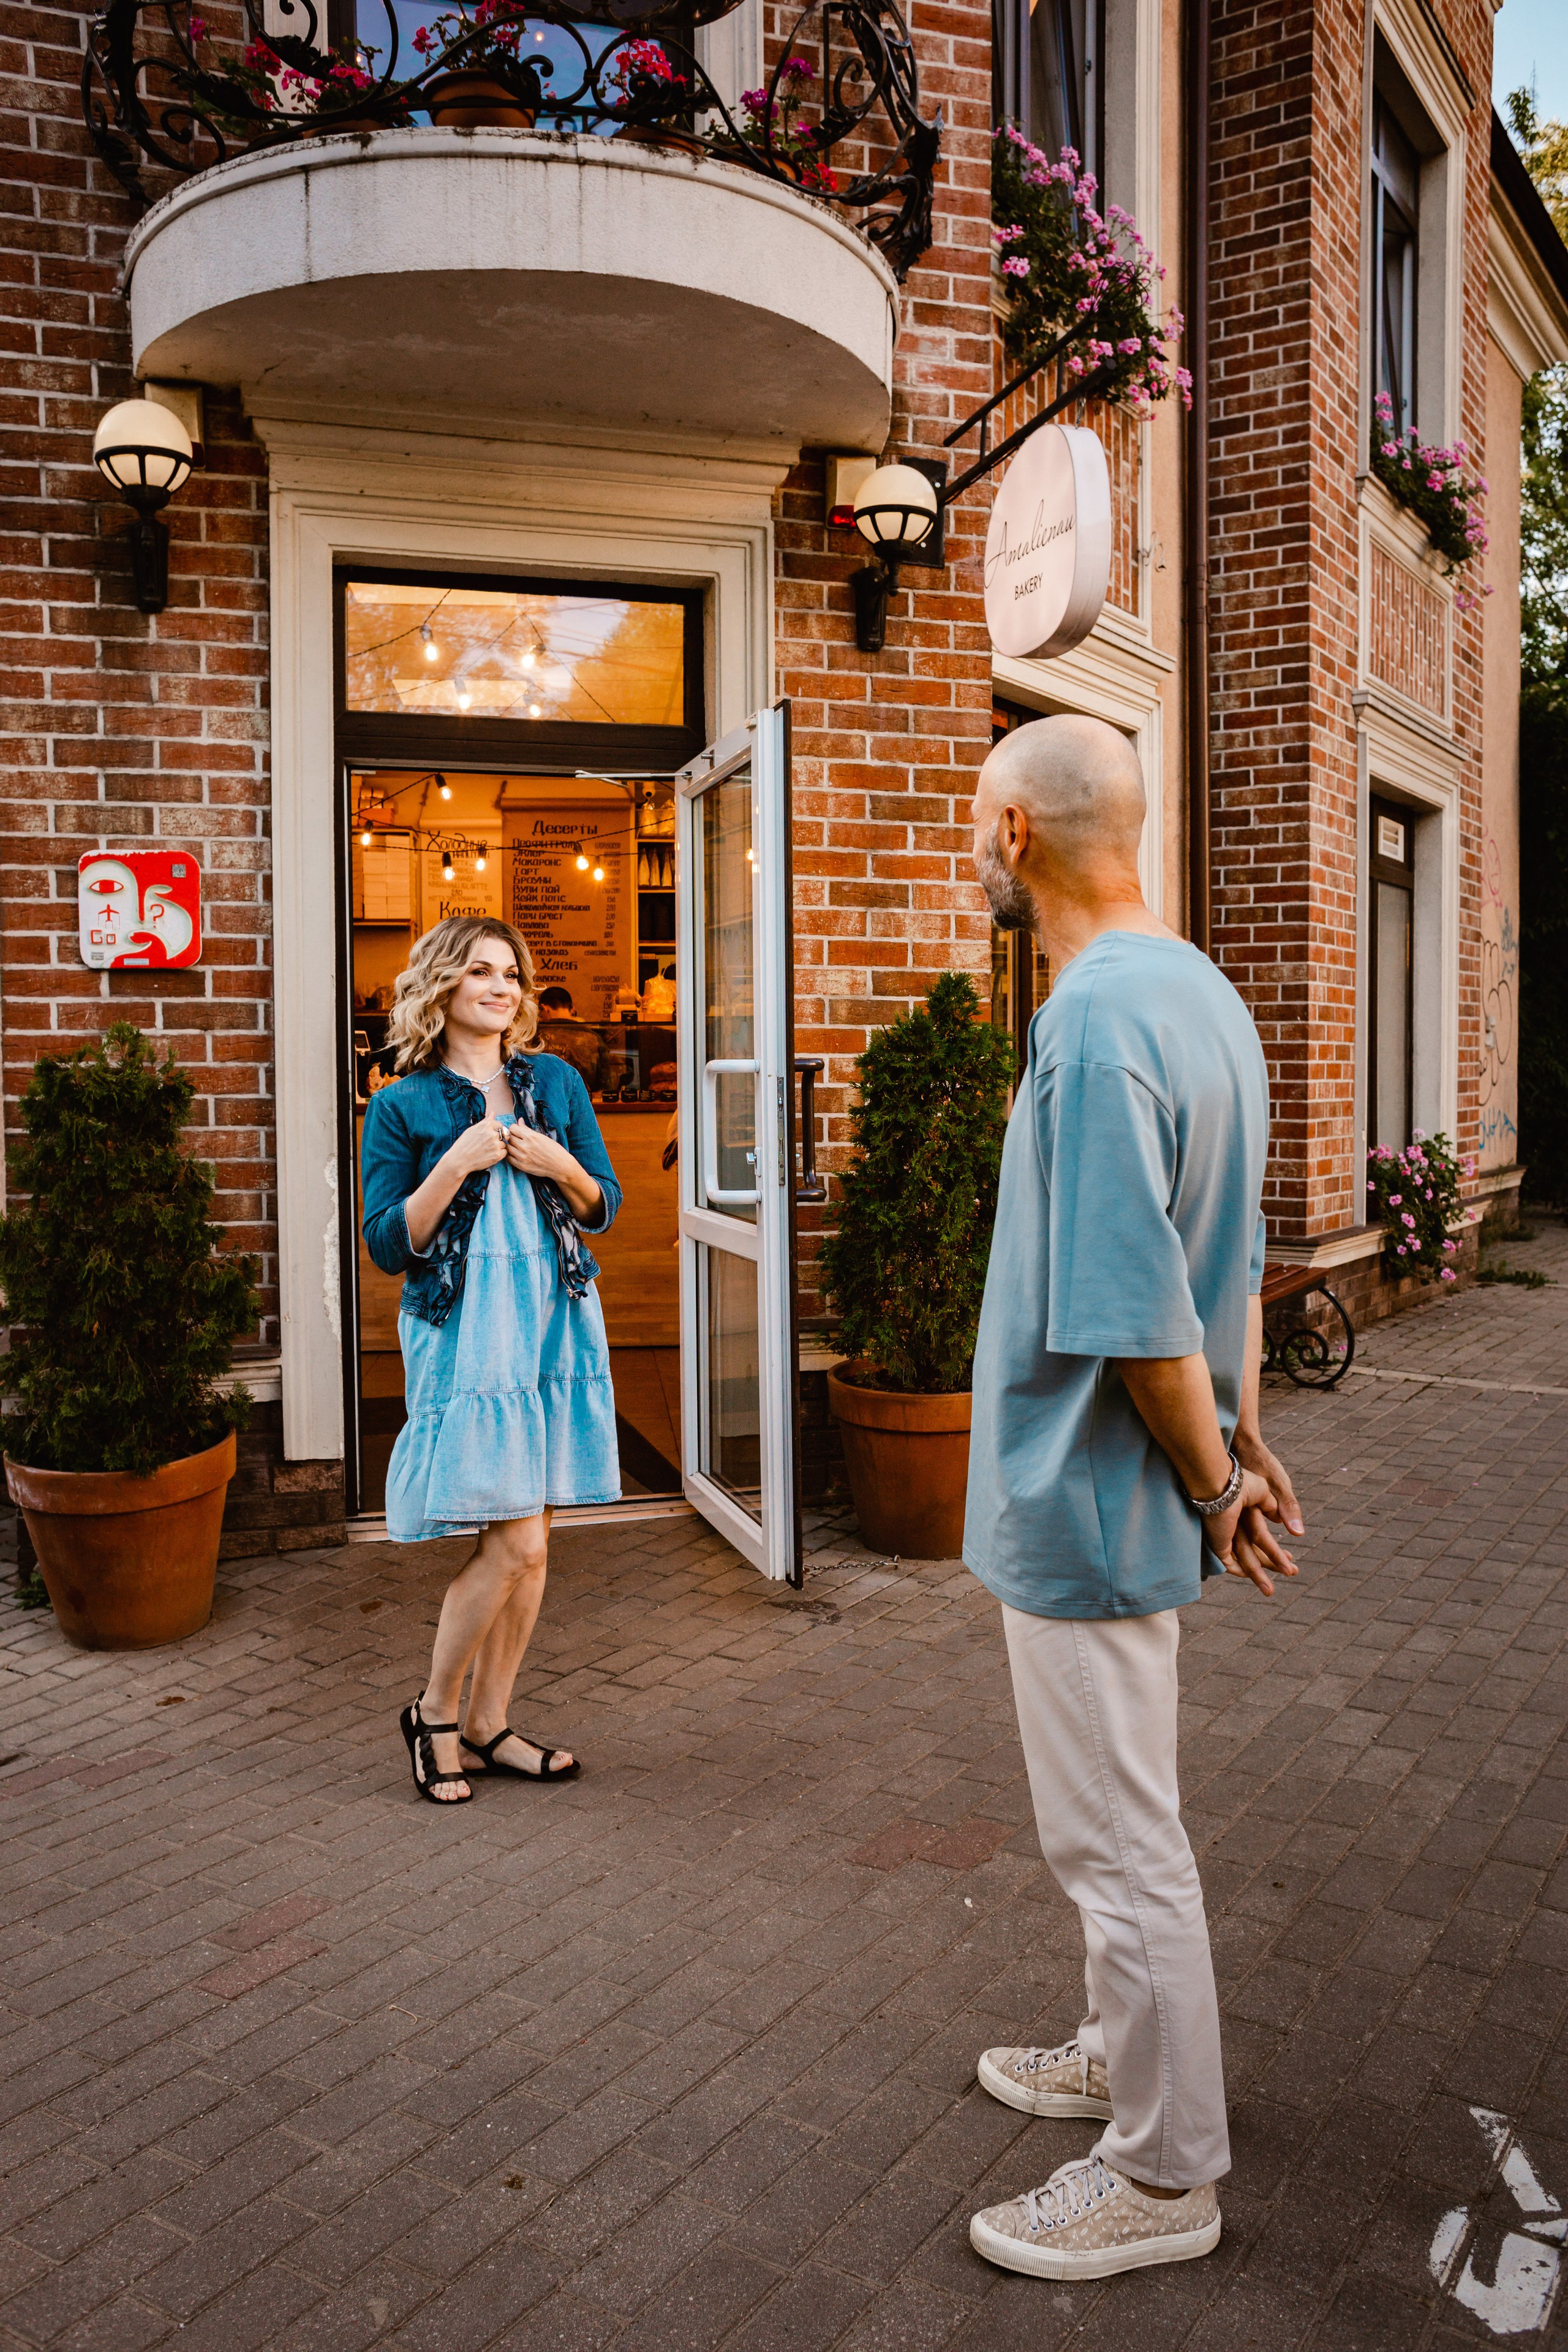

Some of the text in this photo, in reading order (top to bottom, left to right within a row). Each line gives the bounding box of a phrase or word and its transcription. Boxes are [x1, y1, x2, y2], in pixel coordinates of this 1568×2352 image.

[984, 499, 1076, 589] Amalienau
[1015, 573, 1043, 601] BAKERY
[532, 820, 598, 836] Десерты
[512, 838, 578, 848] Профитрол
[513, 894, 538, 902] Кейк
[540, 958, 578, 970] Хлеб
